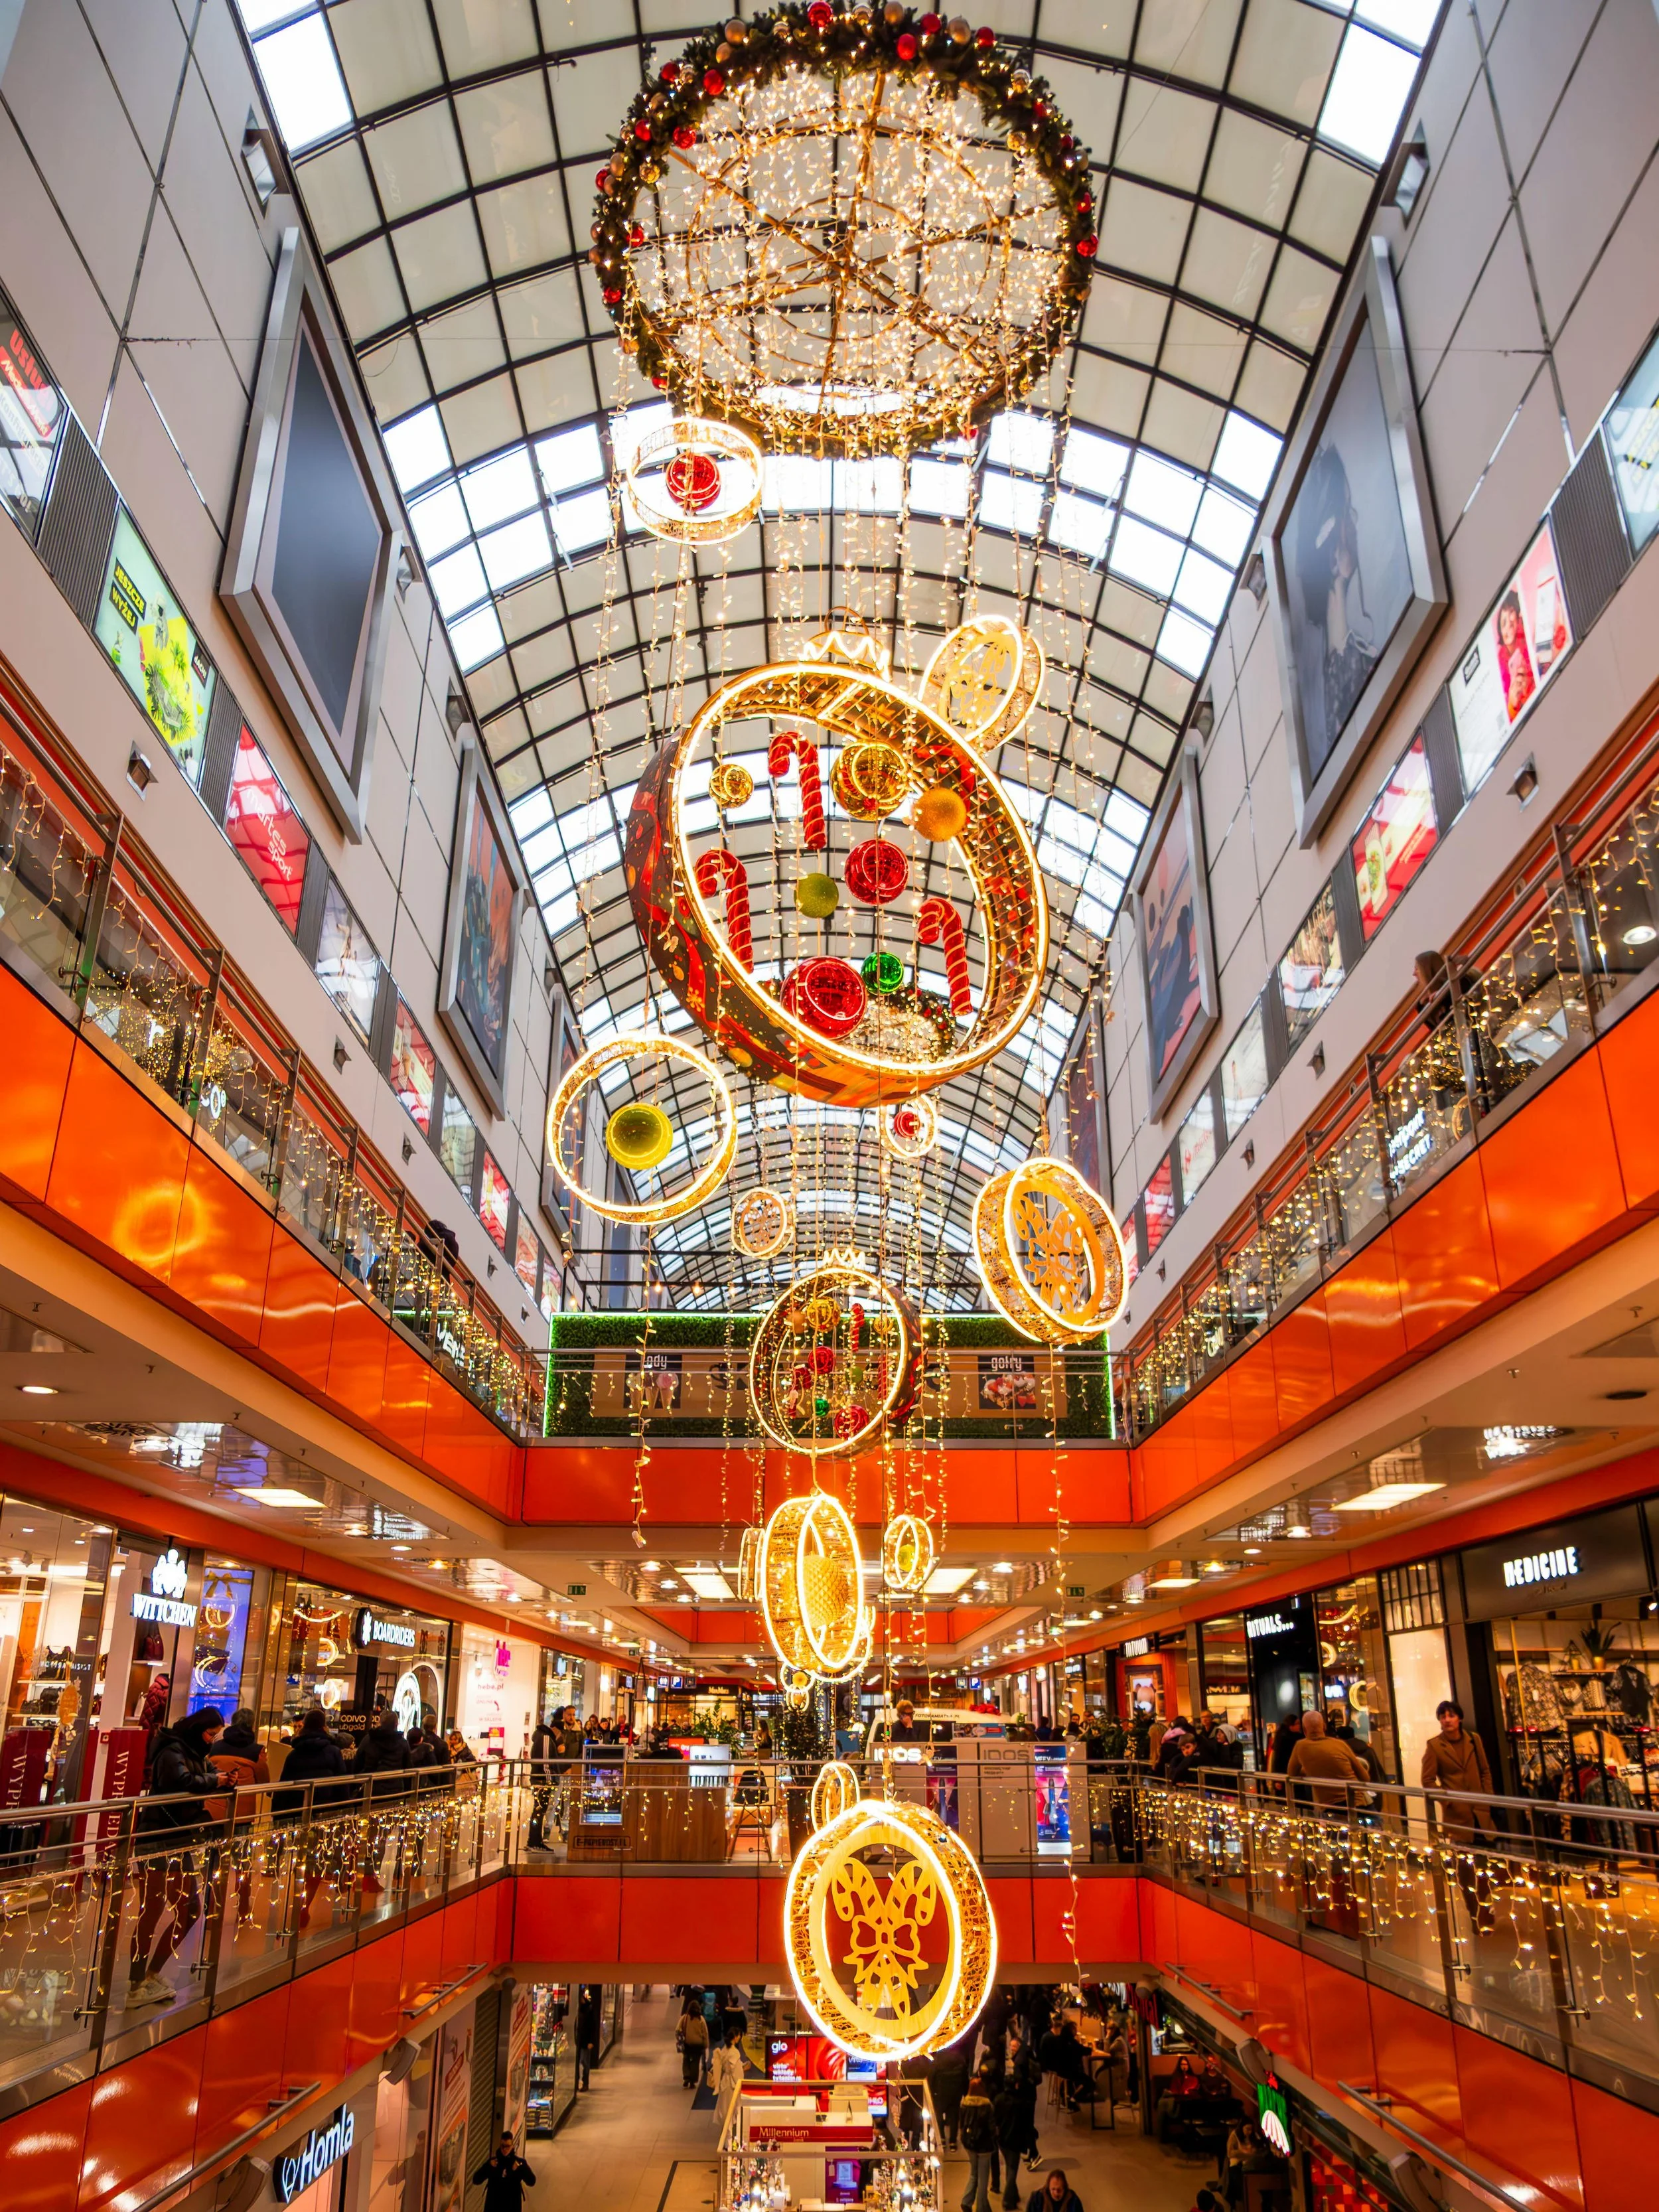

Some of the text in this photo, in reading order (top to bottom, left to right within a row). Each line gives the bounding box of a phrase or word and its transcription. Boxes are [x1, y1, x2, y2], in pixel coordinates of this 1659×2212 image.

[115, 565, 145, 614] JESZCZE
[111, 587, 136, 628] WYŻEJ
[267, 840, 292, 881] sport
[991, 1356, 1022, 1372] gofry
[1503, 1546, 1578, 1587] MEDICINE
[133, 1593, 198, 1627] WITTCHEN
[373, 1620, 415, 1647] BOARDRIDERS
[1125, 1637, 1149, 1658] TATUUM
[477, 1682, 504, 1691] hebe.pl
[771, 2039, 788, 2053] glo
[300, 2102, 354, 2191] Homla
[759, 2126, 810, 2138] Millennium
